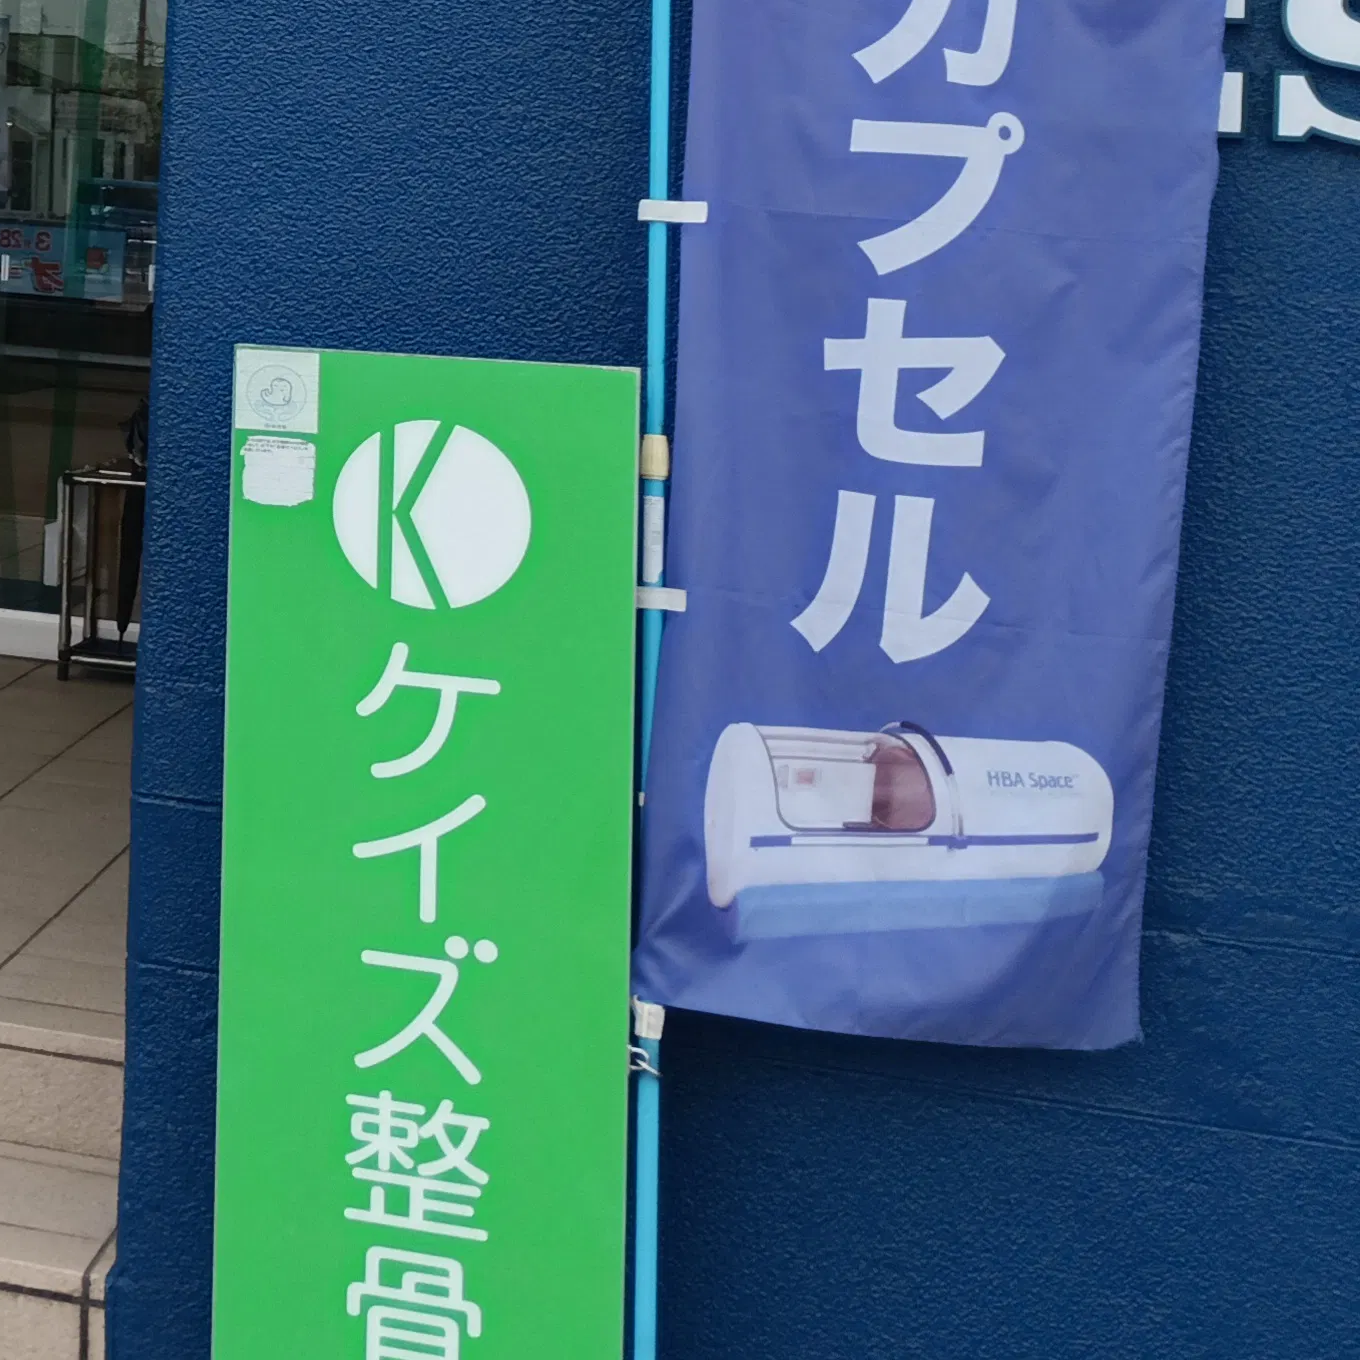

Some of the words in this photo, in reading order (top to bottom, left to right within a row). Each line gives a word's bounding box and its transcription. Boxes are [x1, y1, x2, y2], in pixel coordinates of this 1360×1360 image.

[987, 770, 1025, 787] HBA
[1029, 772, 1074, 790] Space
[343, 641, 501, 1360] ケイズ整骨
